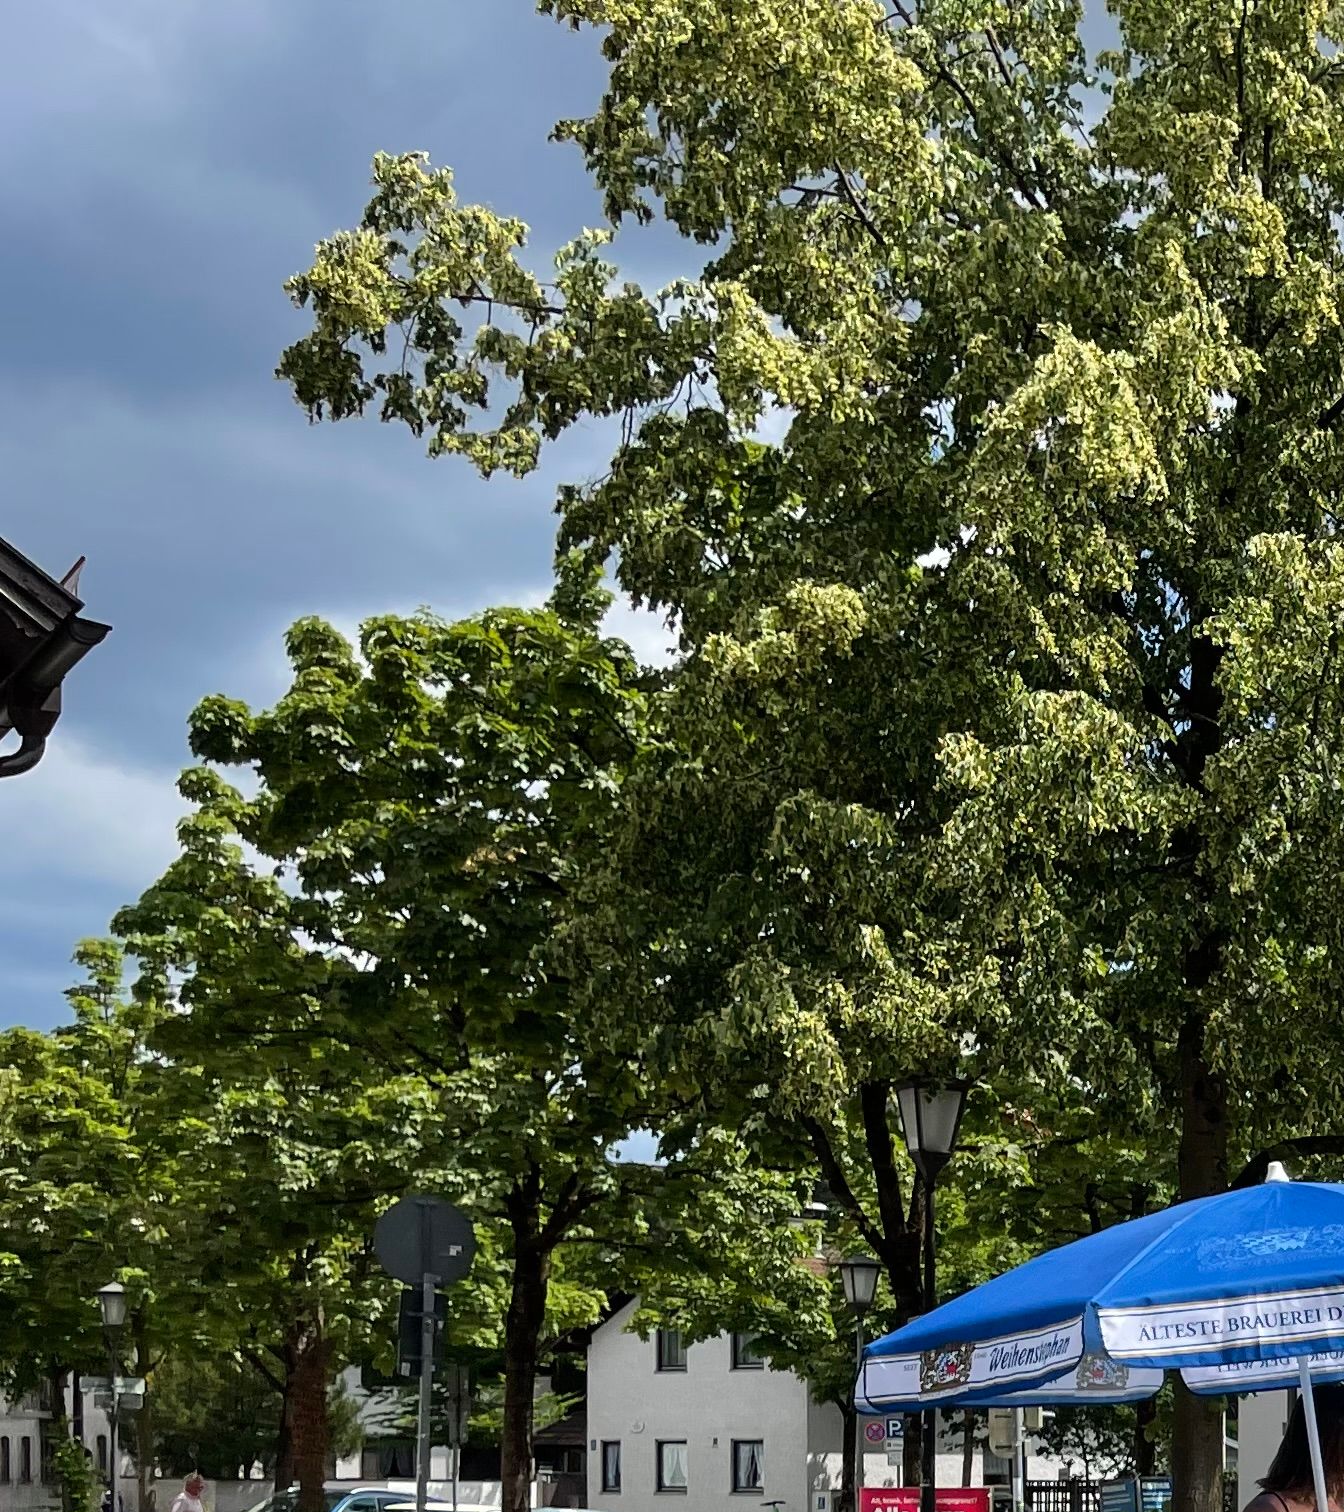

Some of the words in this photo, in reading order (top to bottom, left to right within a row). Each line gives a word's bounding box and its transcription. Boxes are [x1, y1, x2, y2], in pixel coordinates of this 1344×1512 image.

[1139, 1320, 1223, 1342] ÄLTESTE
[1228, 1308, 1321, 1333] BRAUEREI
[989, 1335, 1071, 1373] Weihenstephan
[889, 1421, 902, 1437] P
